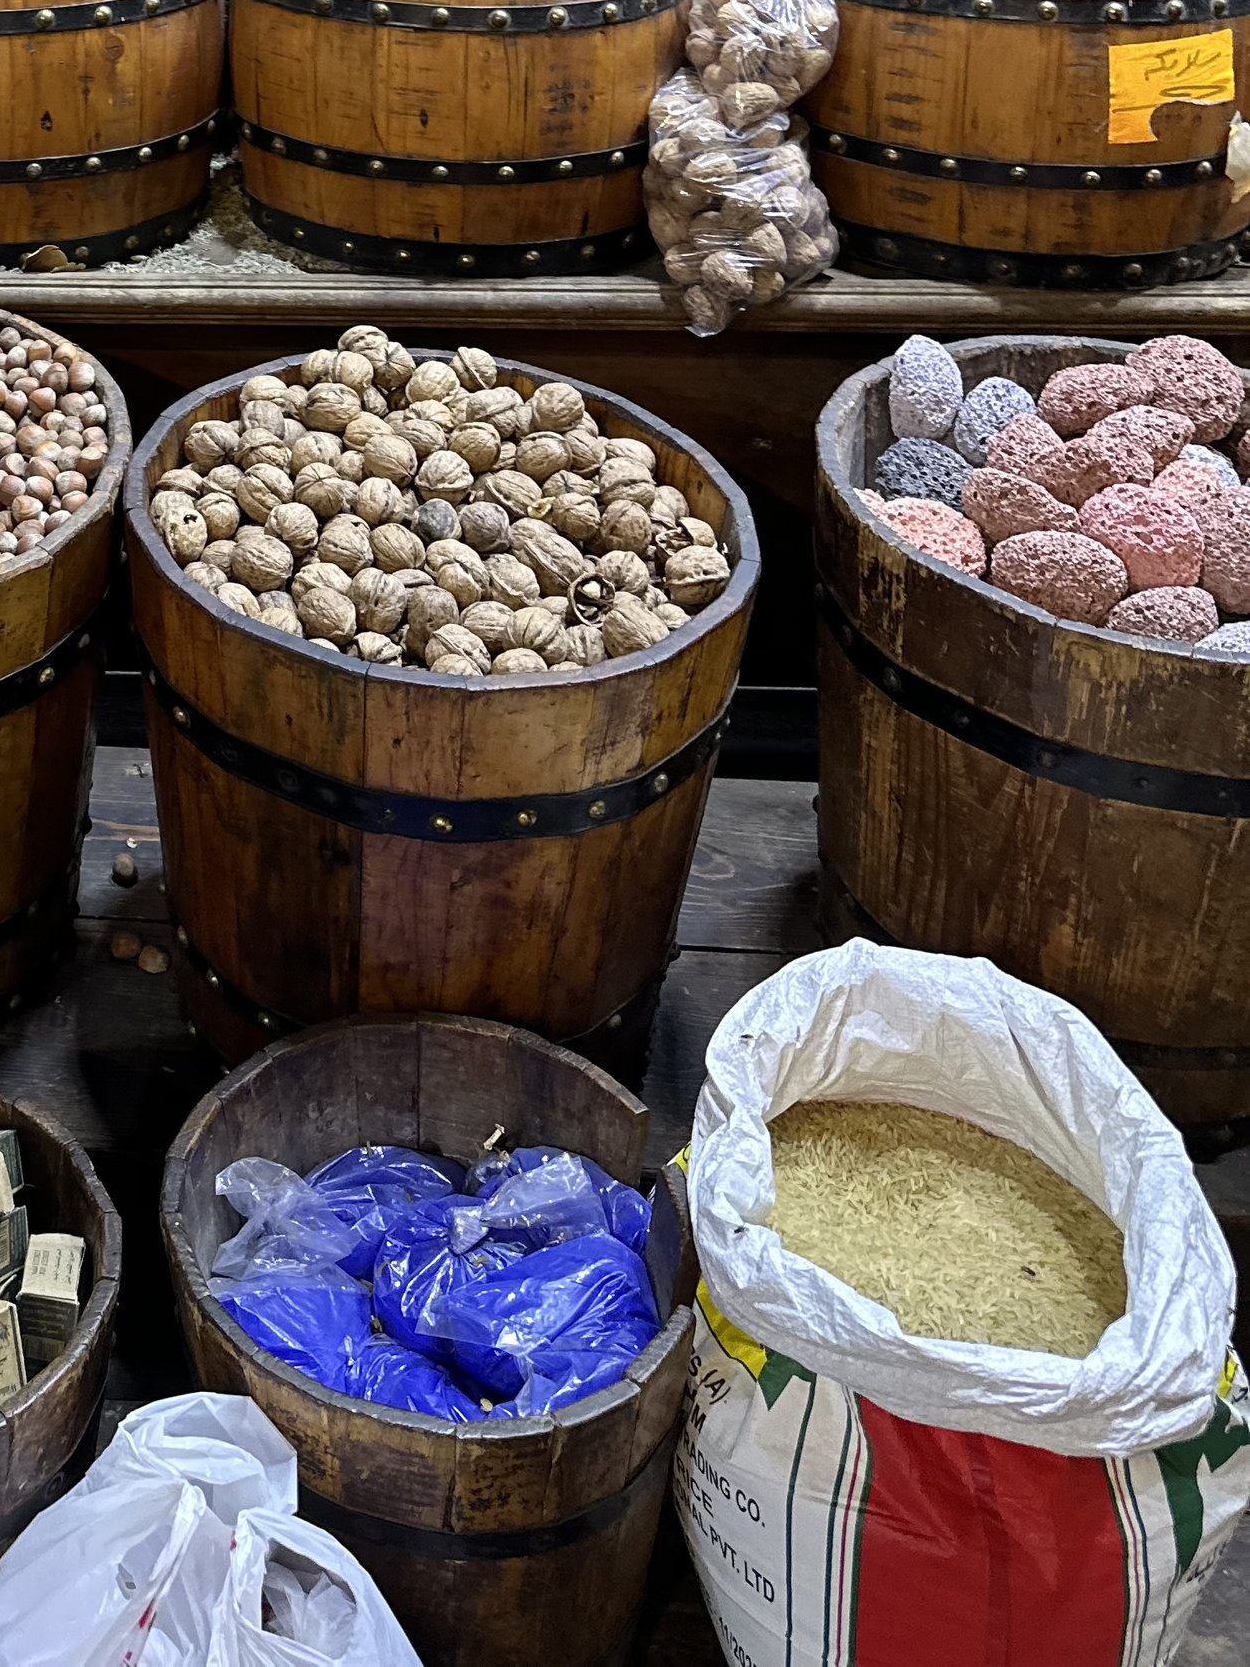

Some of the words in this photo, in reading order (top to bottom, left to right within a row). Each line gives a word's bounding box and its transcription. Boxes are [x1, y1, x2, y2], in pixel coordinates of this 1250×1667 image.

[676, 1453, 714, 1519] RICE
[682, 1426, 731, 1500] RADING
[735, 1489, 766, 1528] CO.
[709, 1524, 740, 1574] PVT.
[743, 1559, 775, 1603] LTD
